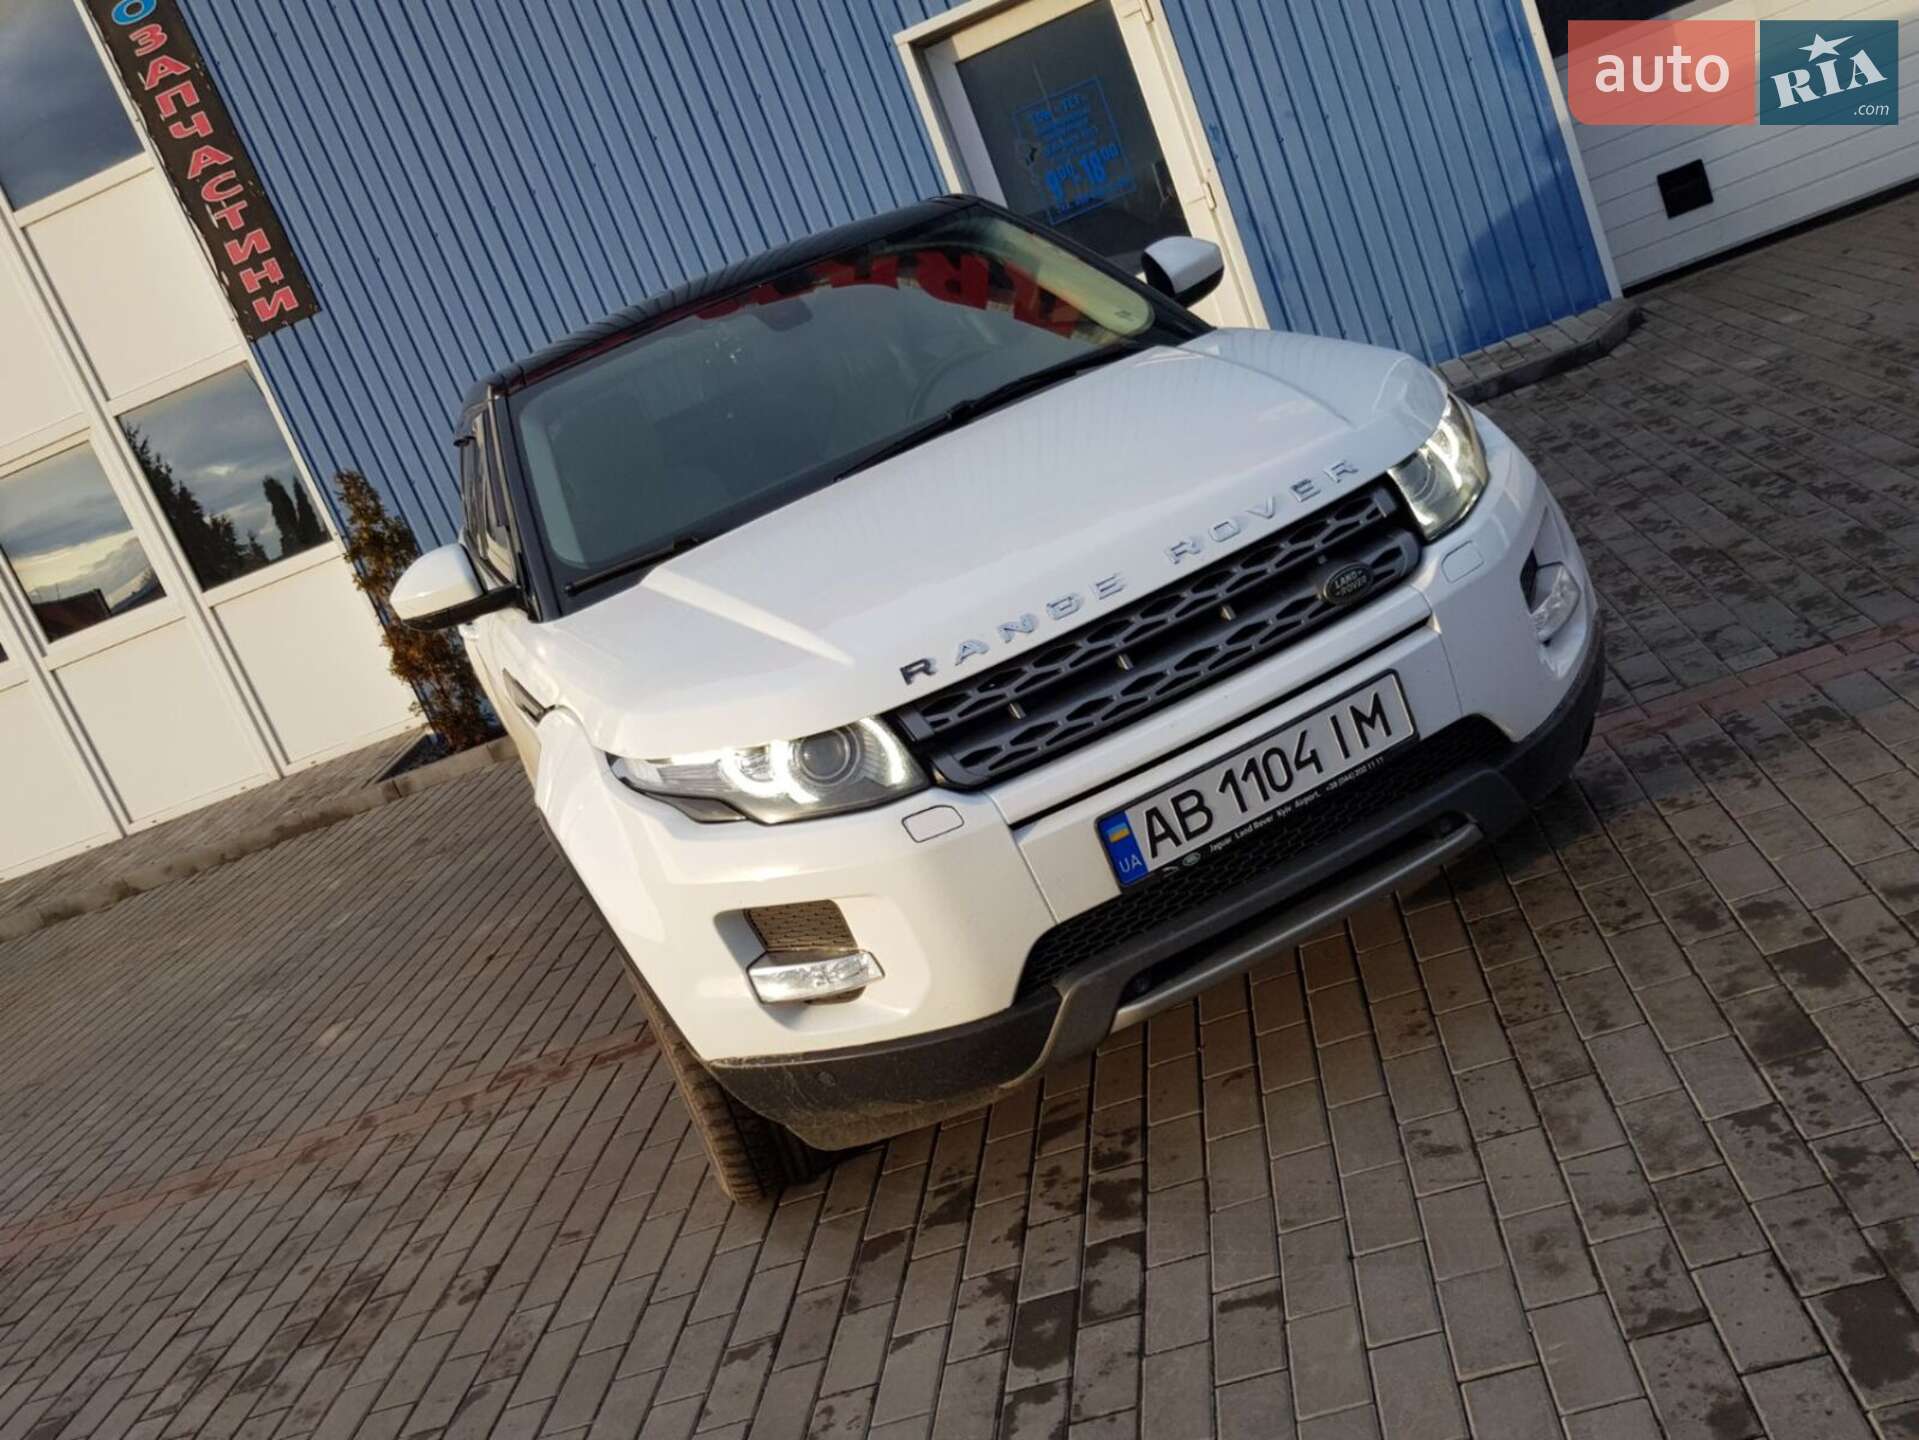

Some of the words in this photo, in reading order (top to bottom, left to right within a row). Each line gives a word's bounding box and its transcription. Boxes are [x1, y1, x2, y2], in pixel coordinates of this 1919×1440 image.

[900, 573, 1126, 686] RANGE
[1164, 458, 1359, 565] ROVER
[1335, 570, 1358, 589] LAND
[1145, 789, 1214, 858] AB
[1218, 730, 1324, 813] 1104
[1330, 692, 1392, 759] IM
[1234, 824, 1253, 839] Land
[1252, 815, 1274, 831] Rover
[1119, 854, 1142, 873] UA
